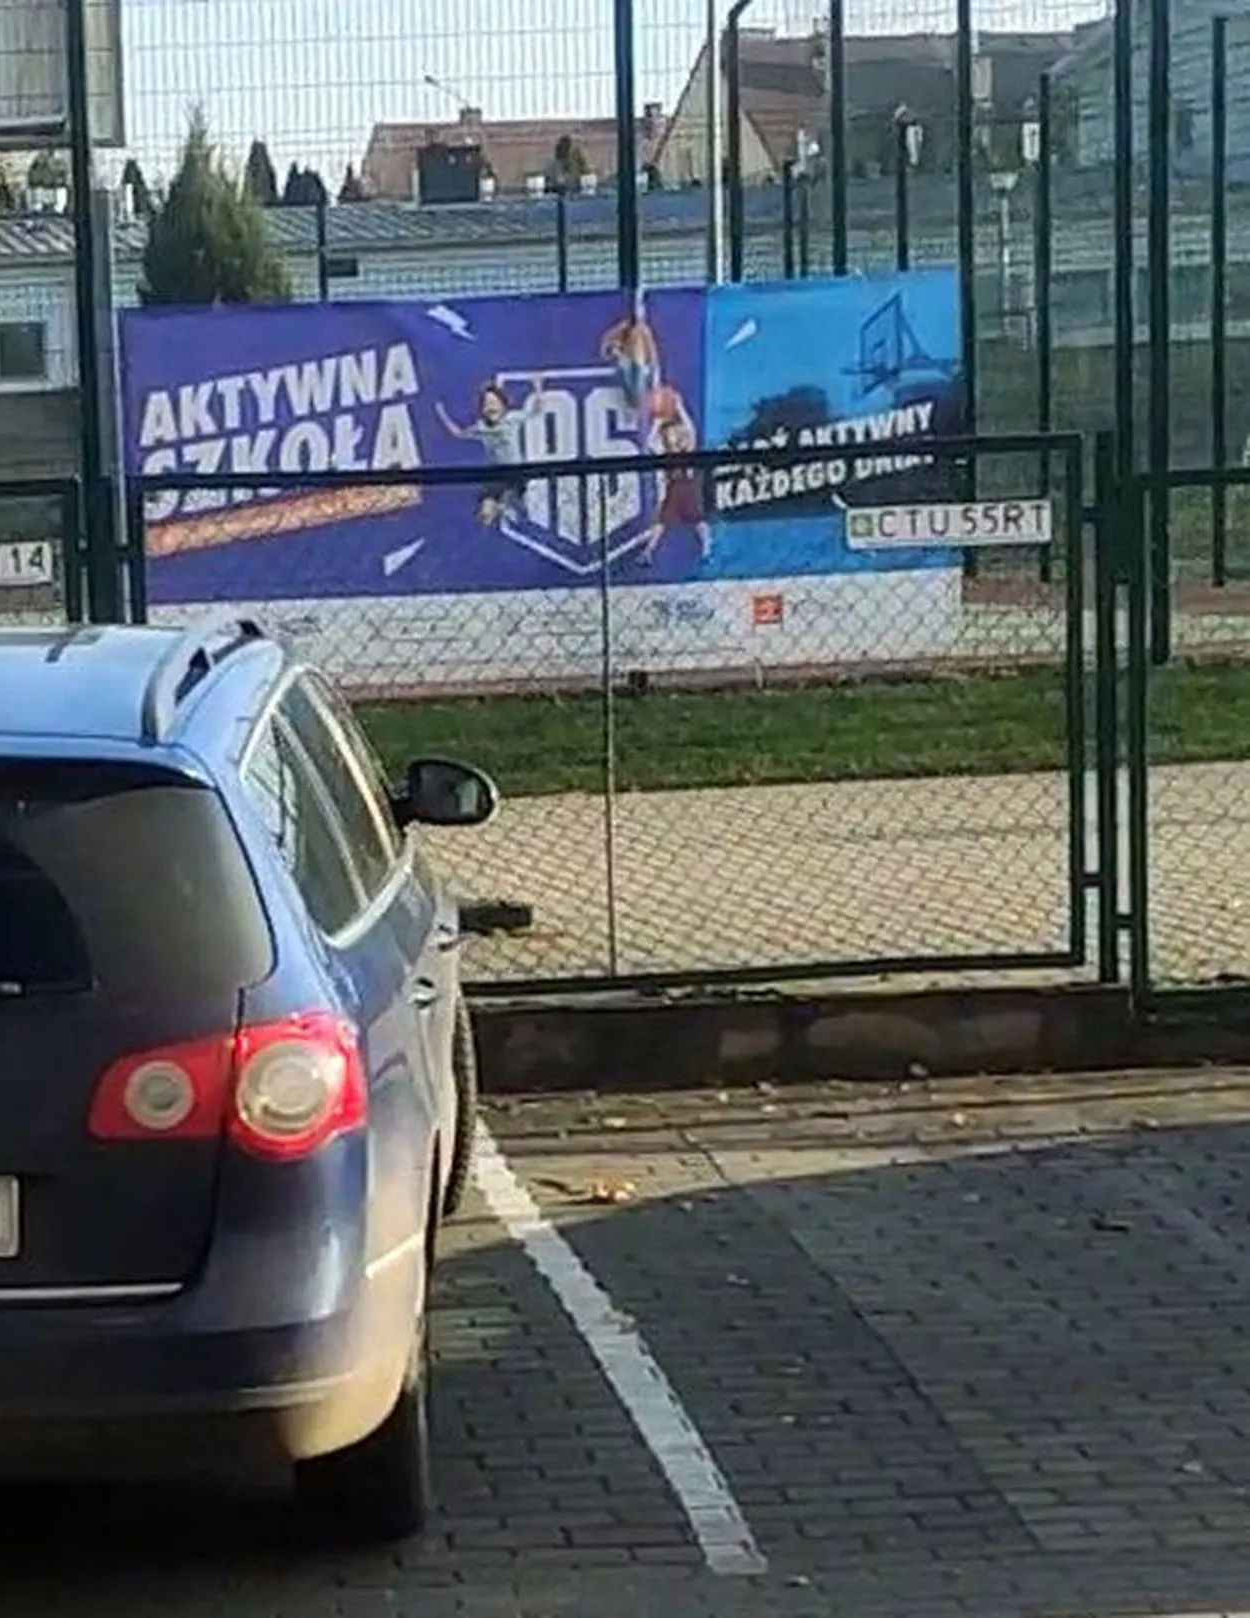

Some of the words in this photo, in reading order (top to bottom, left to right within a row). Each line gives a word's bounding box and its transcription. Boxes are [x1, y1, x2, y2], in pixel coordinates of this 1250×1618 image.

[140, 341, 419, 446] AKTYWNA
[799, 402, 933, 447] AKTYWNY
[716, 458, 848, 510] KAŻDEGO
[878, 510, 950, 537] CTU
